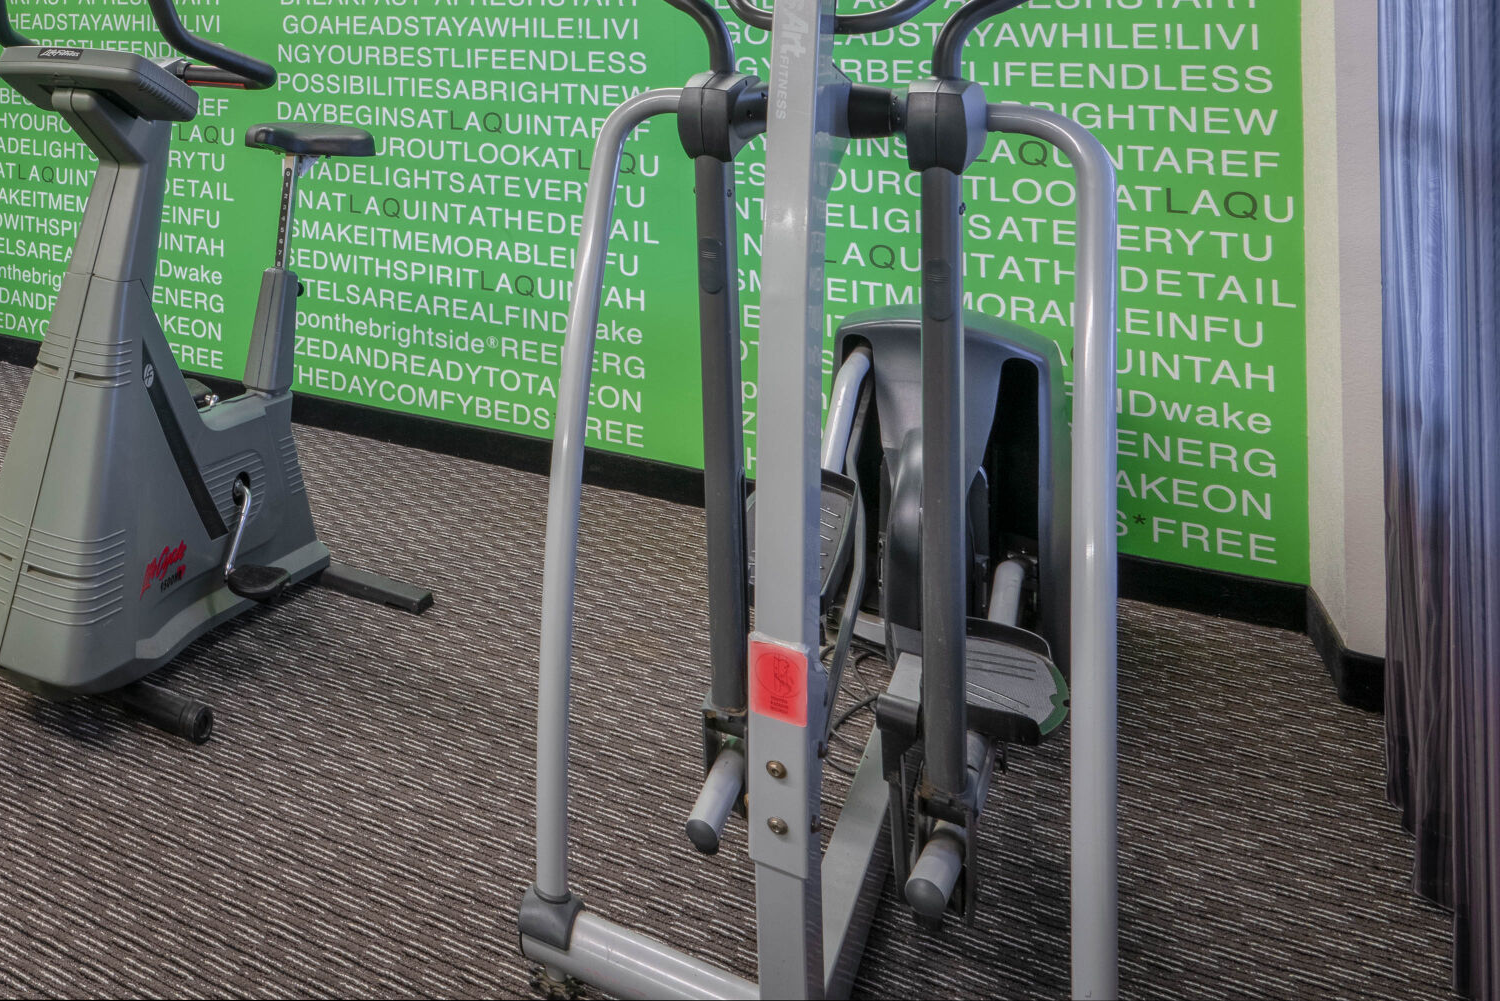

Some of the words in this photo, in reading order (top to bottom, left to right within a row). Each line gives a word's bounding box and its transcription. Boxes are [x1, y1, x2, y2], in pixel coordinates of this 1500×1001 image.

[283, 14, 638, 41] GOAHEADSTAYAWHILE!LIVI
[278, 43, 647, 75] NGYOURBESTLIFEENDLESS
[774, 55, 789, 120] FITNESS
